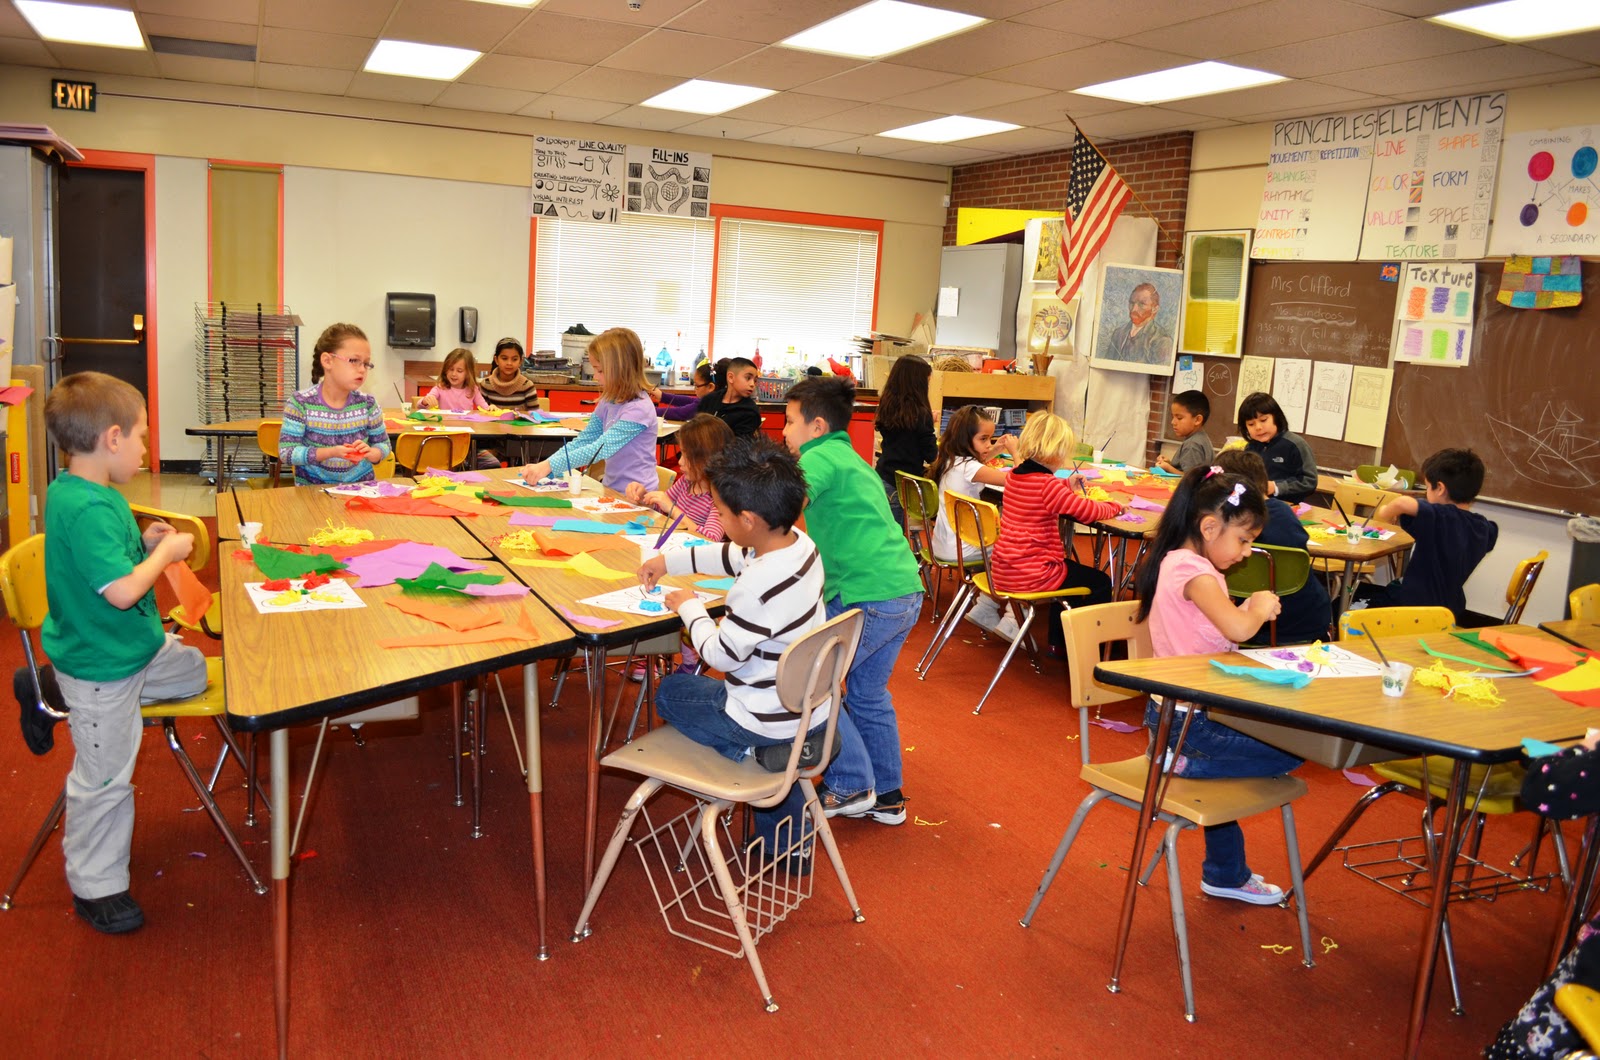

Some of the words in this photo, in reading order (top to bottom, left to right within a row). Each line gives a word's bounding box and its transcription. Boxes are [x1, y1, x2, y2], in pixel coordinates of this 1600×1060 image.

[57, 82, 93, 110] EXIT
[1378, 93, 1505, 136] ELEMENTS
[1274, 112, 1375, 147] PRINCIPLES
[597, 141, 626, 153] QUALITY
[1376, 139, 1407, 157] LINE
[1438, 133, 1480, 152] SHAPE
[1529, 136, 1571, 147] COMBINING
[1270, 150, 1310, 164] MOVEMENT
[1320, 147, 1360, 160] REPETITION
[1267, 170, 1305, 183] BALANCE
[1371, 173, 1409, 192] COLOR
[1432, 170, 1469, 188] FORM
[1568, 185, 1592, 194] MAKES
[1260, 208, 1294, 221] UNITY
[1428, 206, 1470, 224] SPACE
[1536, 235, 1543, 244] A
[1550, 233, 1598, 244] SECONDARY
[1385, 243, 1440, 259] TEXTURE
[1271, 275, 1293, 293] Mrs
[1299, 275, 1352, 298] Clifford
